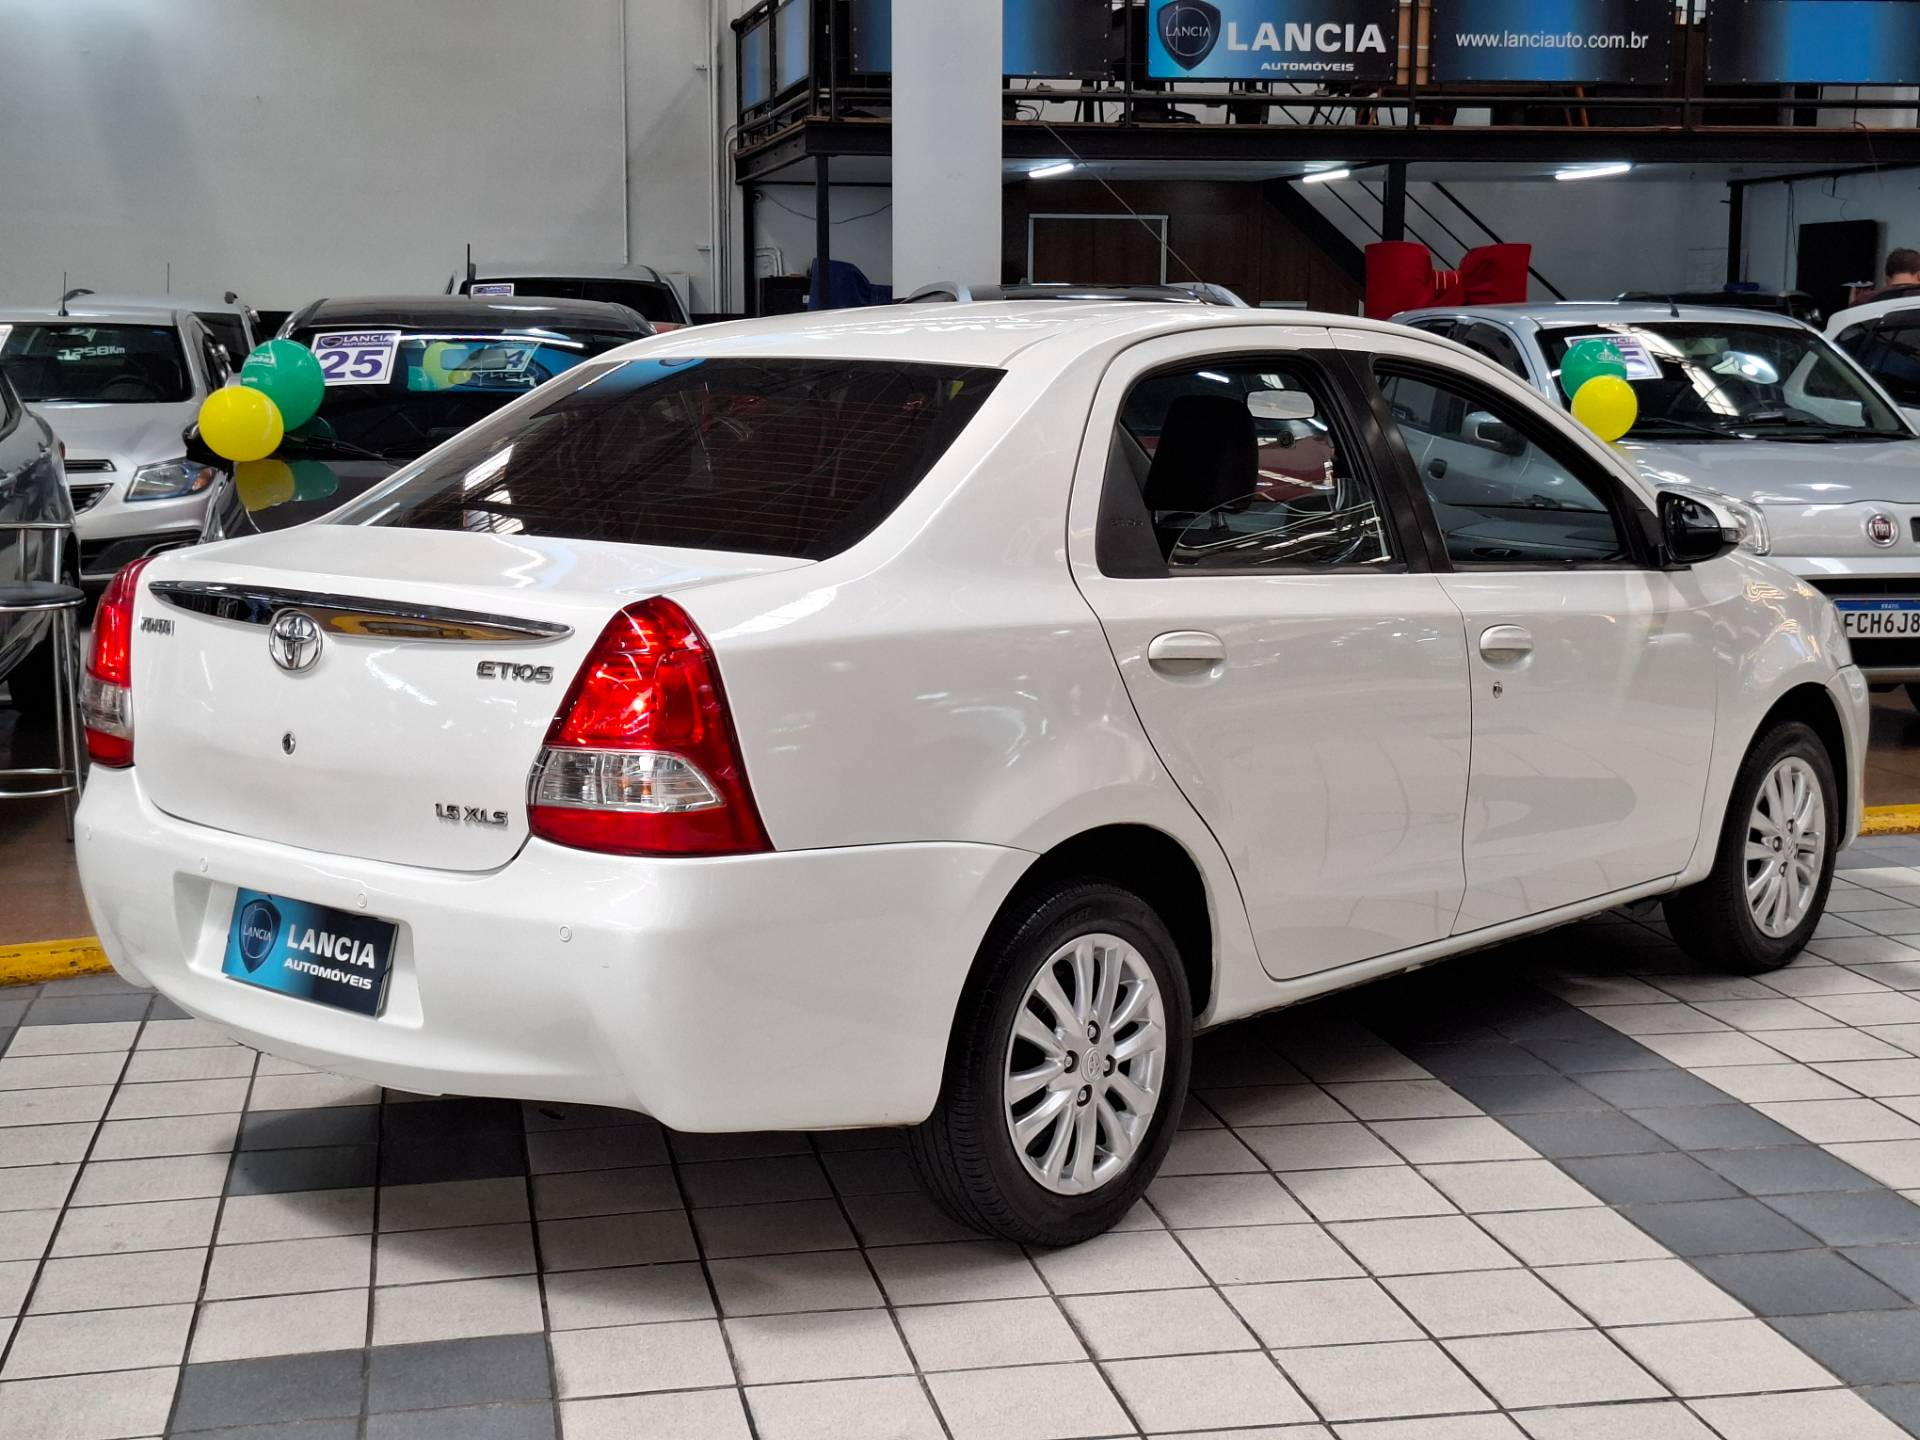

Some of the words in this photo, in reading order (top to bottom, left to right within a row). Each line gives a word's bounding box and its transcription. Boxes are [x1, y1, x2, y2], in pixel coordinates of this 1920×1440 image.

[1165, 26, 1212, 38] LANCIA
[1227, 22, 1387, 53] LANCIA
[1455, 30, 1649, 49] www.lanciauto.com.br
[1260, 61, 1355, 72] AUTOMÓVEIS
[319, 350, 385, 379] 25
[476, 660, 555, 684] ETIOS
[463, 805, 509, 829] XLS
[243, 925, 272, 942] LANCIA
[286, 923, 376, 970] LANCIA
[283, 957, 373, 991] AUTOMÓVEIS
